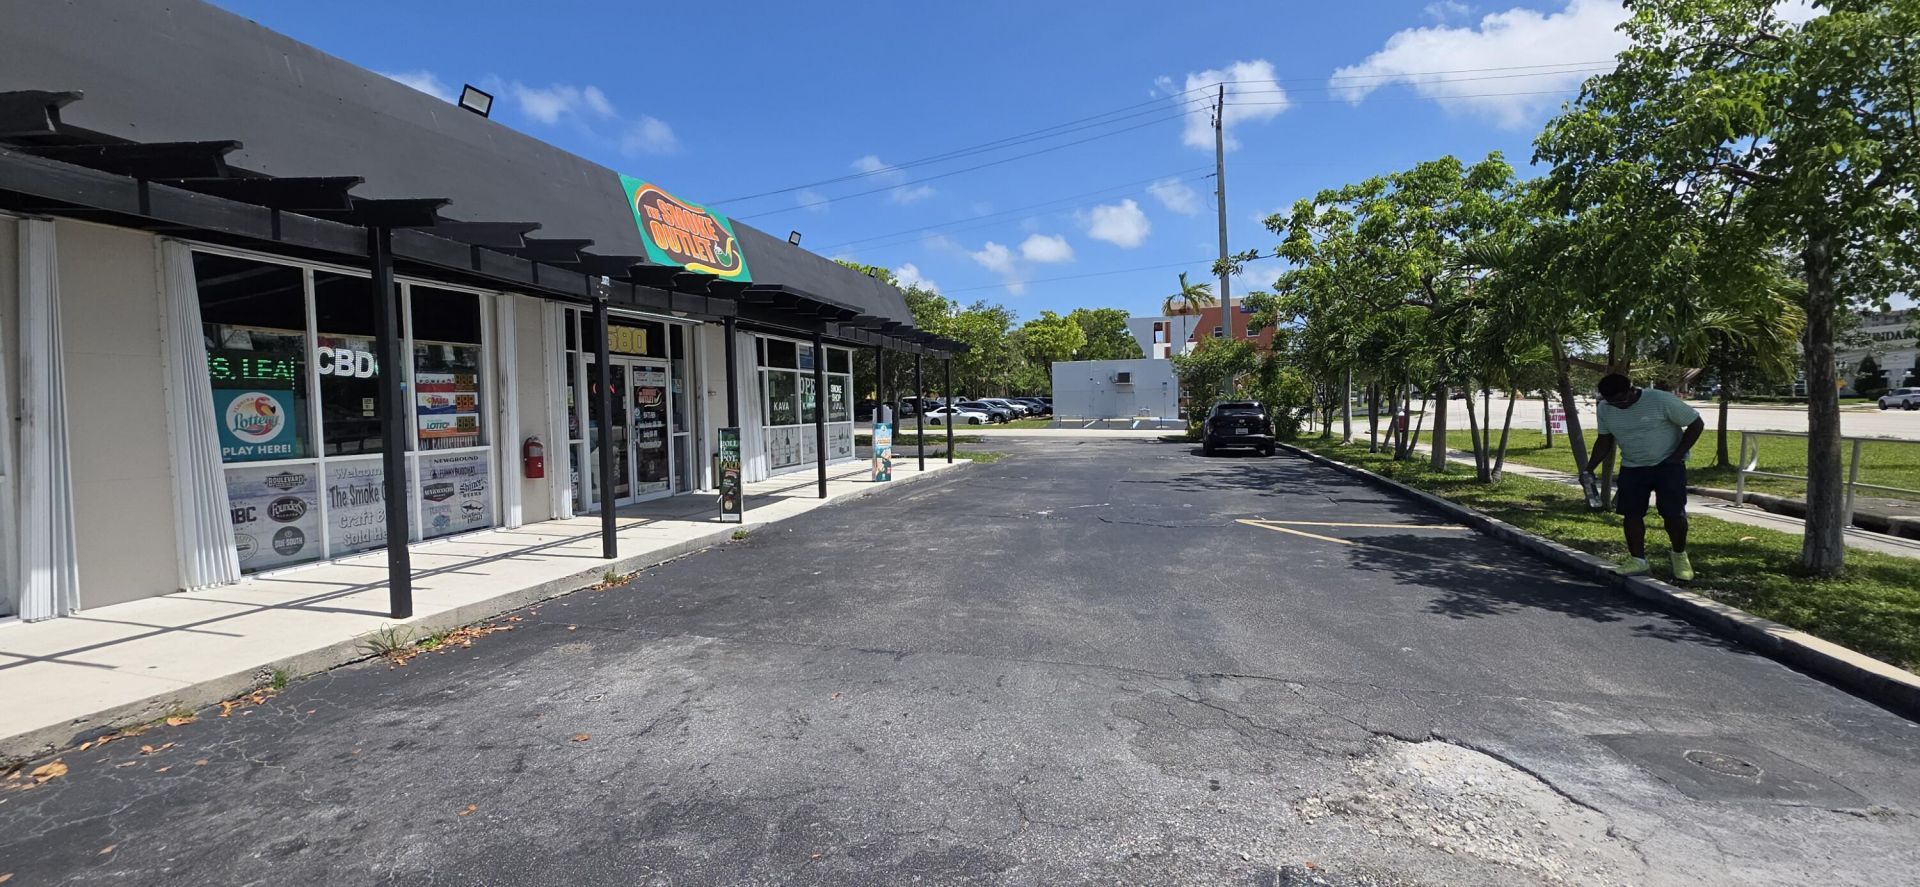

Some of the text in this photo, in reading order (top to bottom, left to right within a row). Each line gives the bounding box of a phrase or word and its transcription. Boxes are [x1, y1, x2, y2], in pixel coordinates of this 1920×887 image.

[657, 199, 719, 241] SMOKE
[650, 221, 716, 264] OUTLET
[317, 346, 374, 378] CBD
[800, 377, 816, 396] OPE
[831, 393, 841, 401] SHOP
[773, 401, 789, 411] KAVA
[427, 421, 449, 430] LOTTO
[223, 445, 291, 456] PLAY HERE!
[433, 455, 479, 464] NEWGROUND
[335, 467, 384, 479] Welcom
[268, 474, 303, 487] BOULEVARD
[329, 485, 347, 508] The
[349, 482, 380, 506] Smoke
[339, 512, 374, 529] Craft
[286, 537, 303, 546] SOUTH
[343, 529, 371, 546] Sold
